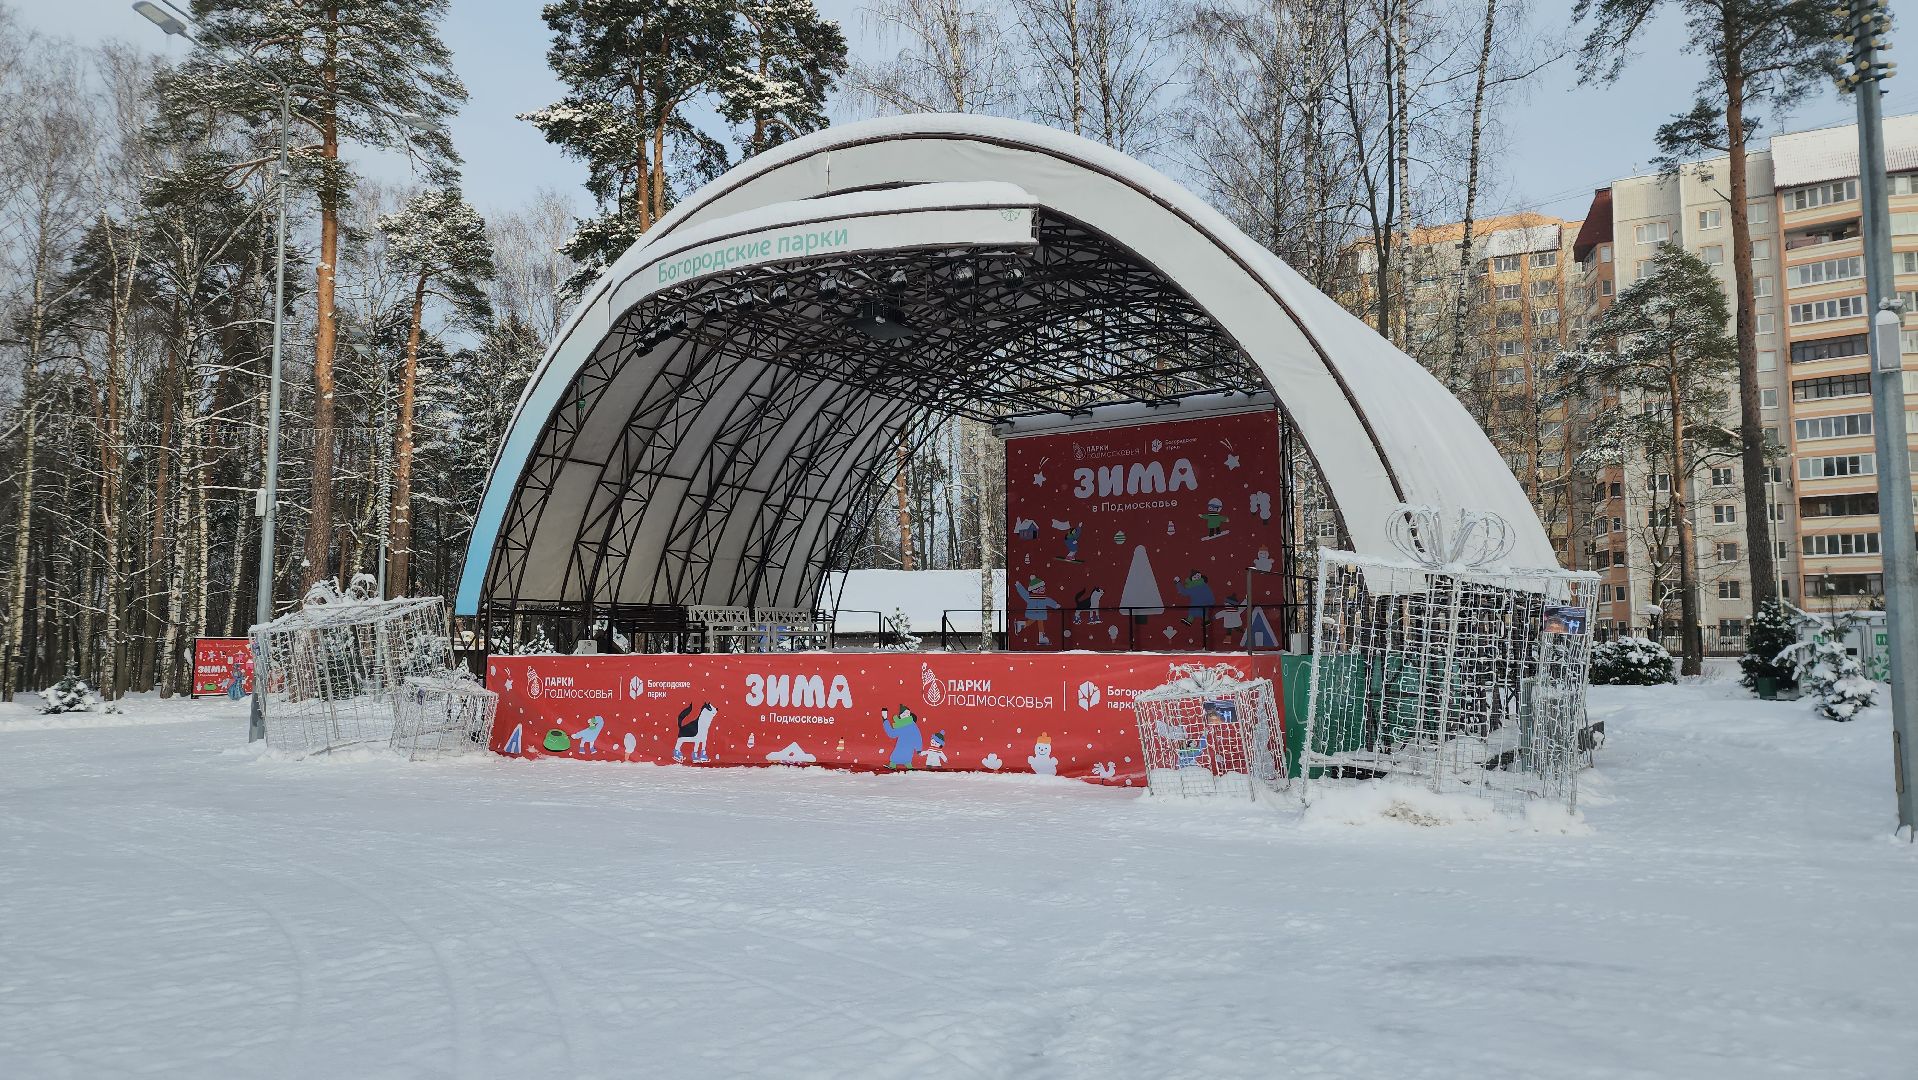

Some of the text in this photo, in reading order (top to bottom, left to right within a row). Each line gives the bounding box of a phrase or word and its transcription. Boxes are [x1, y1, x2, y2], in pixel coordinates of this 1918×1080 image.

[657, 228, 848, 284] Богородские парки
[1086, 444, 1109, 453] ПАРКИ
[1073, 458, 1198, 498] ЗИМА
[1091, 500, 1178, 513] в Подмосковье
[544, 677, 574, 687] ПАРКИ
[647, 679, 691, 690] Богородские
[947, 679, 992, 692] ПАРКИ
[544, 689, 613, 699] ПОДМОСКОВЬЯ
[745, 673, 853, 709] ЗИМА
[1107, 685, 1145, 700] Богоро
[947, 694, 1053, 709] ПОДМОСКОВЬЯ
[760, 712, 835, 725] в Подмосковье
